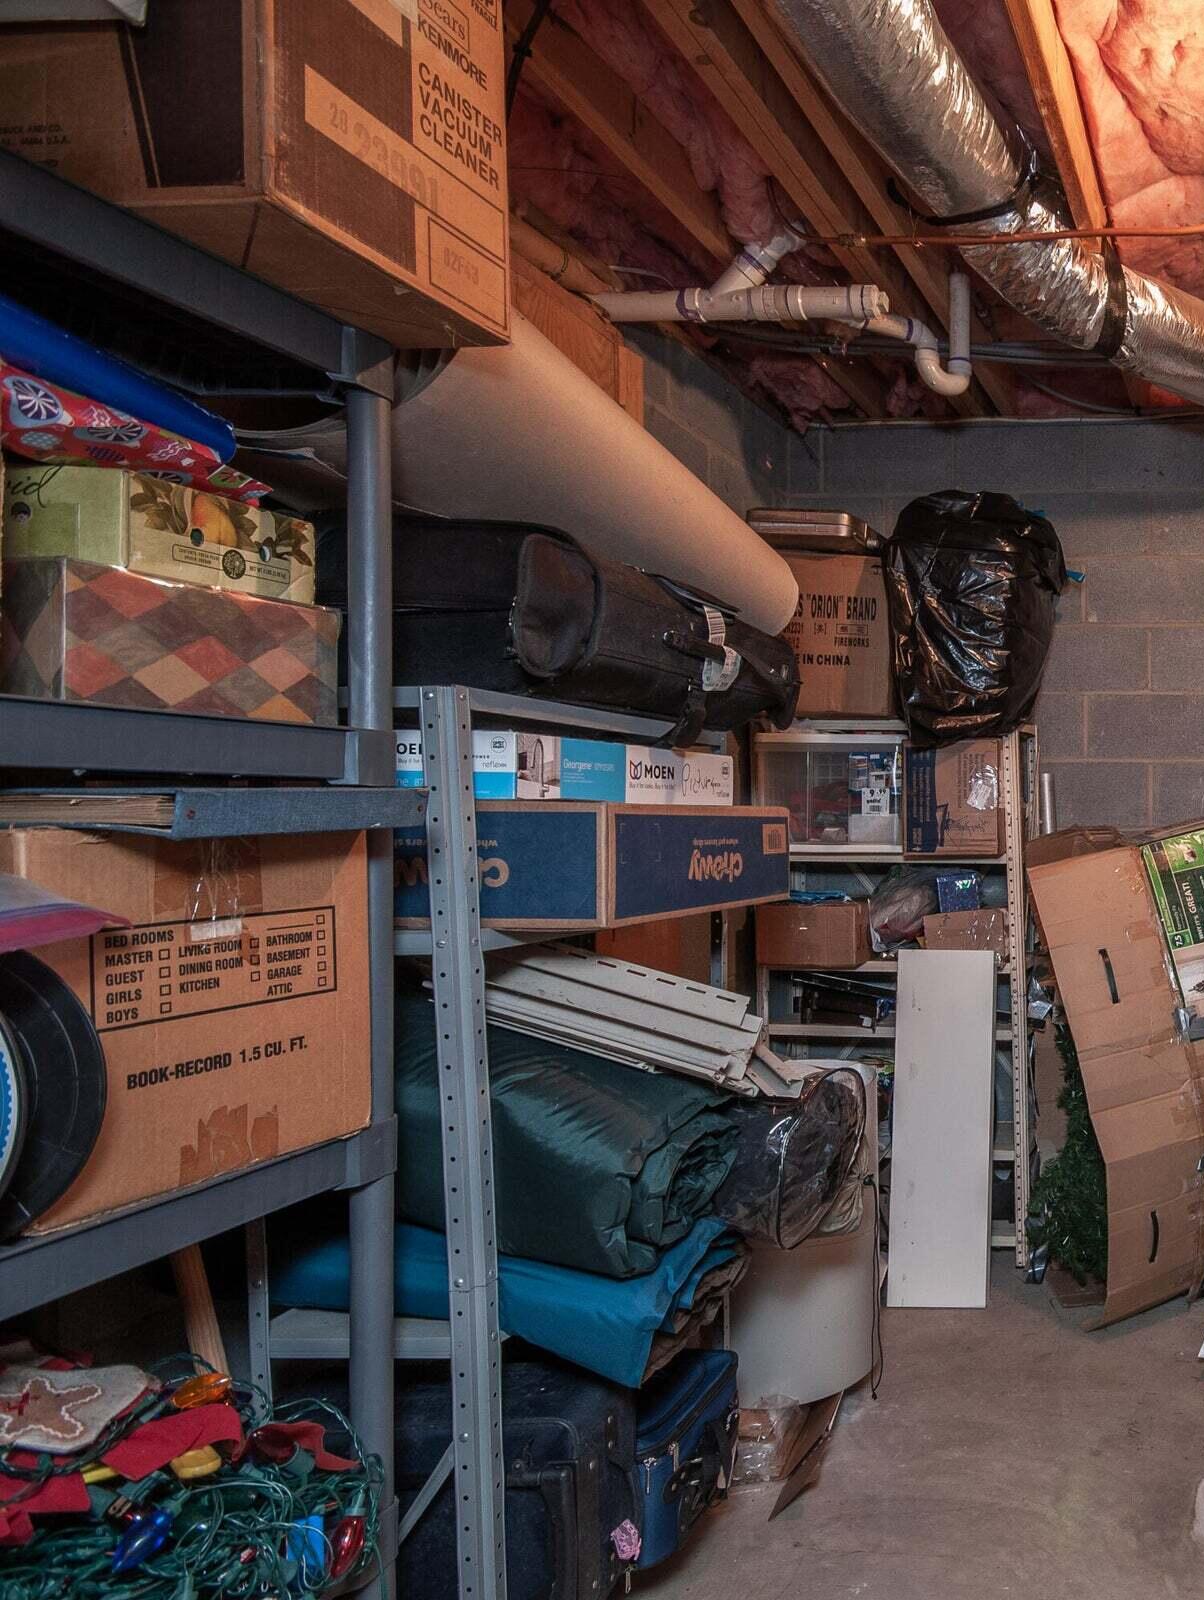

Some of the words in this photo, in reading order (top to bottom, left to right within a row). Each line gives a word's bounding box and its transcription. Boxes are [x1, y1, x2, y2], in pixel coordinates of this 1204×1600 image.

[418, 15, 488, 91] KENMORE
[418, 62, 503, 147] CANISTER
[419, 84, 492, 161] VACUUM
[420, 114, 500, 191] CLEANER
[806, 594, 844, 619] "ORION"
[847, 597, 877, 621] BRAND
[834, 637, 870, 648] FIREWORKS
[802, 654, 814, 664] IN
[816, 654, 850, 665] CHINA
[397, 743, 423, 755] OE
[644, 764, 675, 780] MOEN
[688, 848, 743, 883] chewy
[1182, 881, 1197, 914] GREAT!
[104, 933, 128, 949] BED
[131, 930, 174, 946] ROOMS
[266, 931, 312, 947] BATHROOM
[178, 943, 210, 959] LIVING
[213, 940, 242, 955] ROOM
[266, 947, 311, 964] BASEMENT
[105, 950, 153, 968] MASTER
[179, 960, 213, 977] DINING
[215, 956, 243, 971] ROOM
[105, 970, 144, 987] GUEST
[267, 964, 303, 980] GARAGE
[179, 977, 220, 994] KITCHEN
[267, 982, 293, 997] ATTIC
[106, 988, 142, 1005] GIRLS
[106, 1007, 139, 1024] BOYS
[127, 1052, 232, 1091] BOOK-RECORD
[239, 1046, 261, 1064] 1.5
[264, 1040, 287, 1059] CU.
[290, 1035, 308, 1053] FT.
